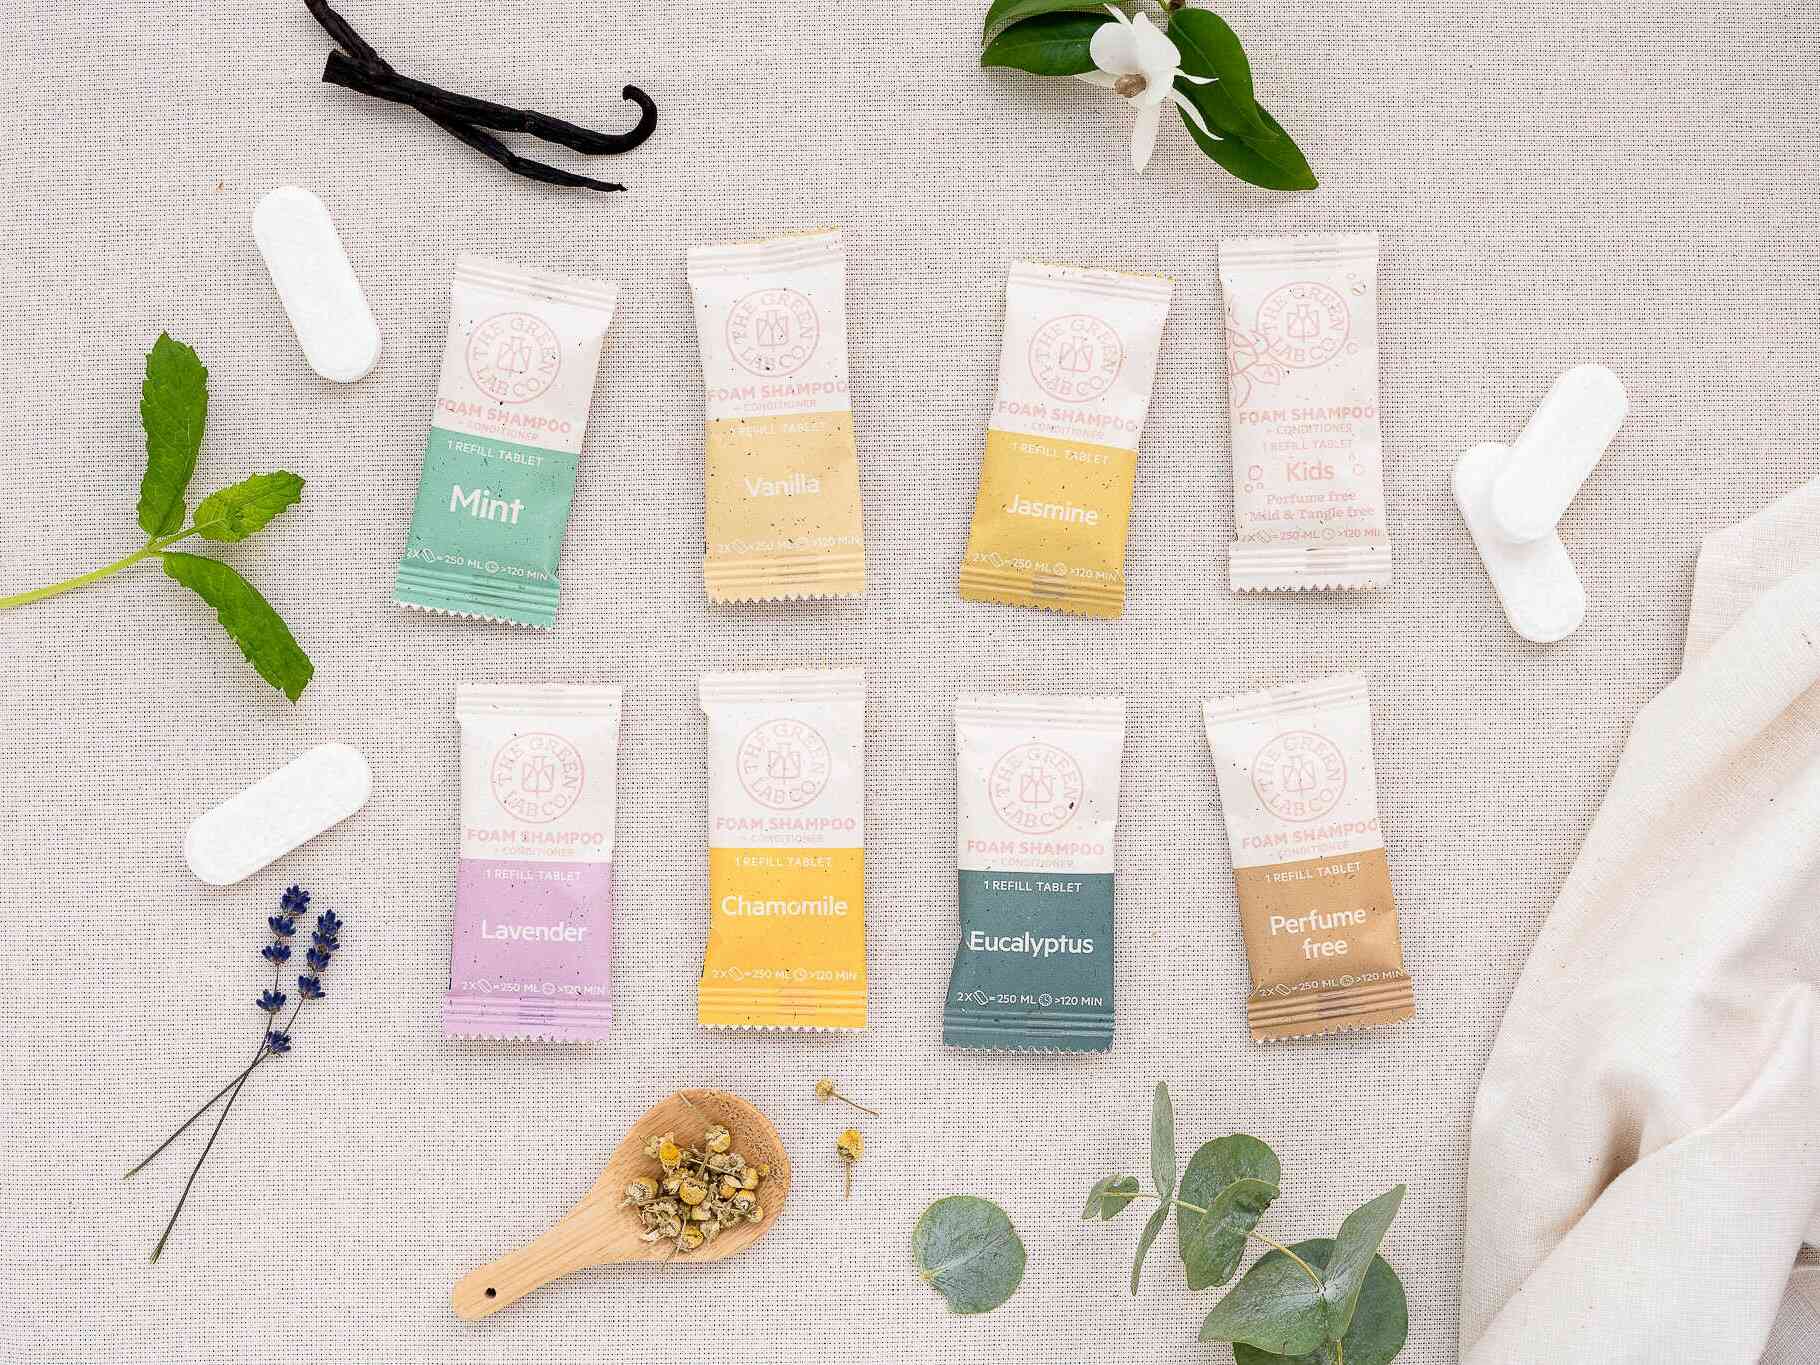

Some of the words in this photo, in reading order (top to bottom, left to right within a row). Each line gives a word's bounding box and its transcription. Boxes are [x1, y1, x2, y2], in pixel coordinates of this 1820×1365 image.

[707, 386, 756, 401] FOAM
[761, 381, 847, 399] SHAMPOO
[436, 398, 482, 418] FOAM
[487, 408, 571, 434] SHAMPOO
[998, 401, 1046, 417] FOAM
[1050, 409, 1137, 432] SHAMPOO
[1240, 410, 1286, 424] FOAM
[1291, 406, 1375, 421] SHAMPOO
[455, 441, 494, 457] REFILL
[499, 450, 544, 466] TABLET
[1065, 449, 1109, 465] TABLET
[1286, 461, 1336, 482] Kids
[744, 473, 820, 497] Vanilla
[450, 484, 525, 525] Mint
[1266, 493, 1325, 505] Perfume
[1328, 490, 1357, 502] free
[1007, 495, 1099, 527] Jasmine
[1283, 511, 1294, 521] &
[1296, 507, 1345, 522] Tangle
[1346, 506, 1376, 519] free
[715, 817, 763, 831] FOAM
[768, 817, 856, 831] SHAMPOO
[1242, 833, 1287, 849] FOAM
[1293, 819, 1377, 844] SHAMPOO
[467, 829, 515, 842] FOAM
[521, 830, 604, 845] SHAMPOO
[968, 840, 1015, 854] FOAM
[1019, 841, 1105, 856] SHAMPOO
[743, 856, 784, 867] REFILL
[788, 856, 832, 867] TABLET
[495, 869, 533, 880] REFILL
[540, 870, 581, 881] TABLET
[1273, 869, 1313, 883] REFILL
[1317, 862, 1361, 878] TABLET
[992, 880, 1032, 892] REFILL
[1036, 881, 1083, 893] TABLET
[721, 895, 849, 917] Chamomile
[481, 919, 587, 942] Lavender
[1269, 908, 1367, 937] Perfume
[970, 930, 1094, 957] Eucalyptus
[1302, 938, 1349, 961] free
[957, 991, 973, 1002] 2X
[1021, 995, 1038, 1005] ML
[1054, 996, 1078, 1006] >120
[1081, 996, 1103, 1007] MIN
